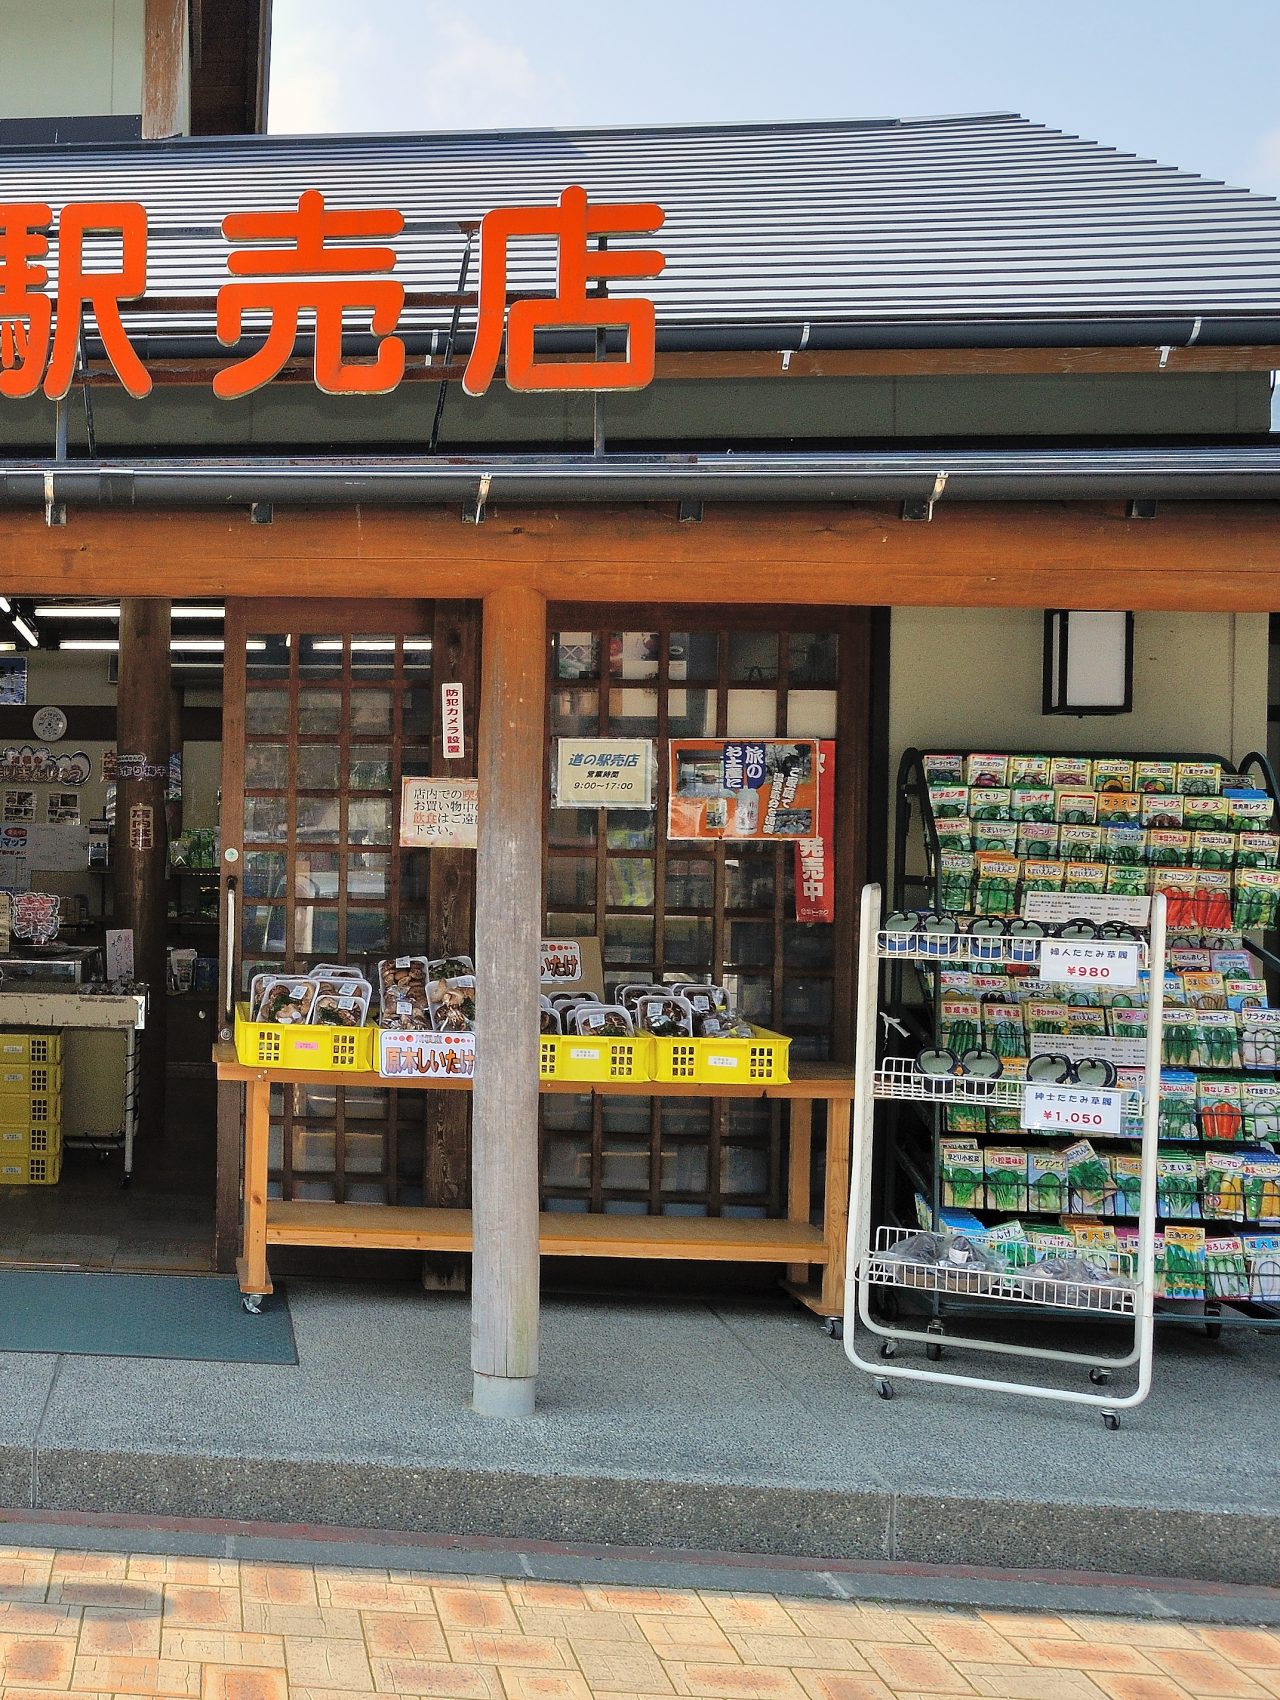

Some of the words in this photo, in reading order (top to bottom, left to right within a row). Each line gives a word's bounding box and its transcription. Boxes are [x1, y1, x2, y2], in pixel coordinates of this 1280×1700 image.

[445, 688, 461, 754] 防犯カメラ設置
[568, 753, 640, 767] 道の駅売店
[725, 746, 743, 788] お土産に
[745, 746, 764, 778] 旅の
[120, 765, 167, 777] 作り梅干
[586, 770, 619, 778] 営業時間
[1146, 800, 1181, 808] サニーレタス
[413, 812, 478, 825] 飲食はご遠
[415, 825, 455, 836] 下さい。
[799, 838, 825, 902] 発売中
[1050, 947, 1128, 960] 婦人たたみ草履
[1066, 966, 1110, 978] ¥980
[385, 1047, 476, 1075] 原木しいたけ
[1035, 1091, 1112, 1106] 紳士たたみ草履
[1043, 1110, 1103, 1125] ¥1,050
